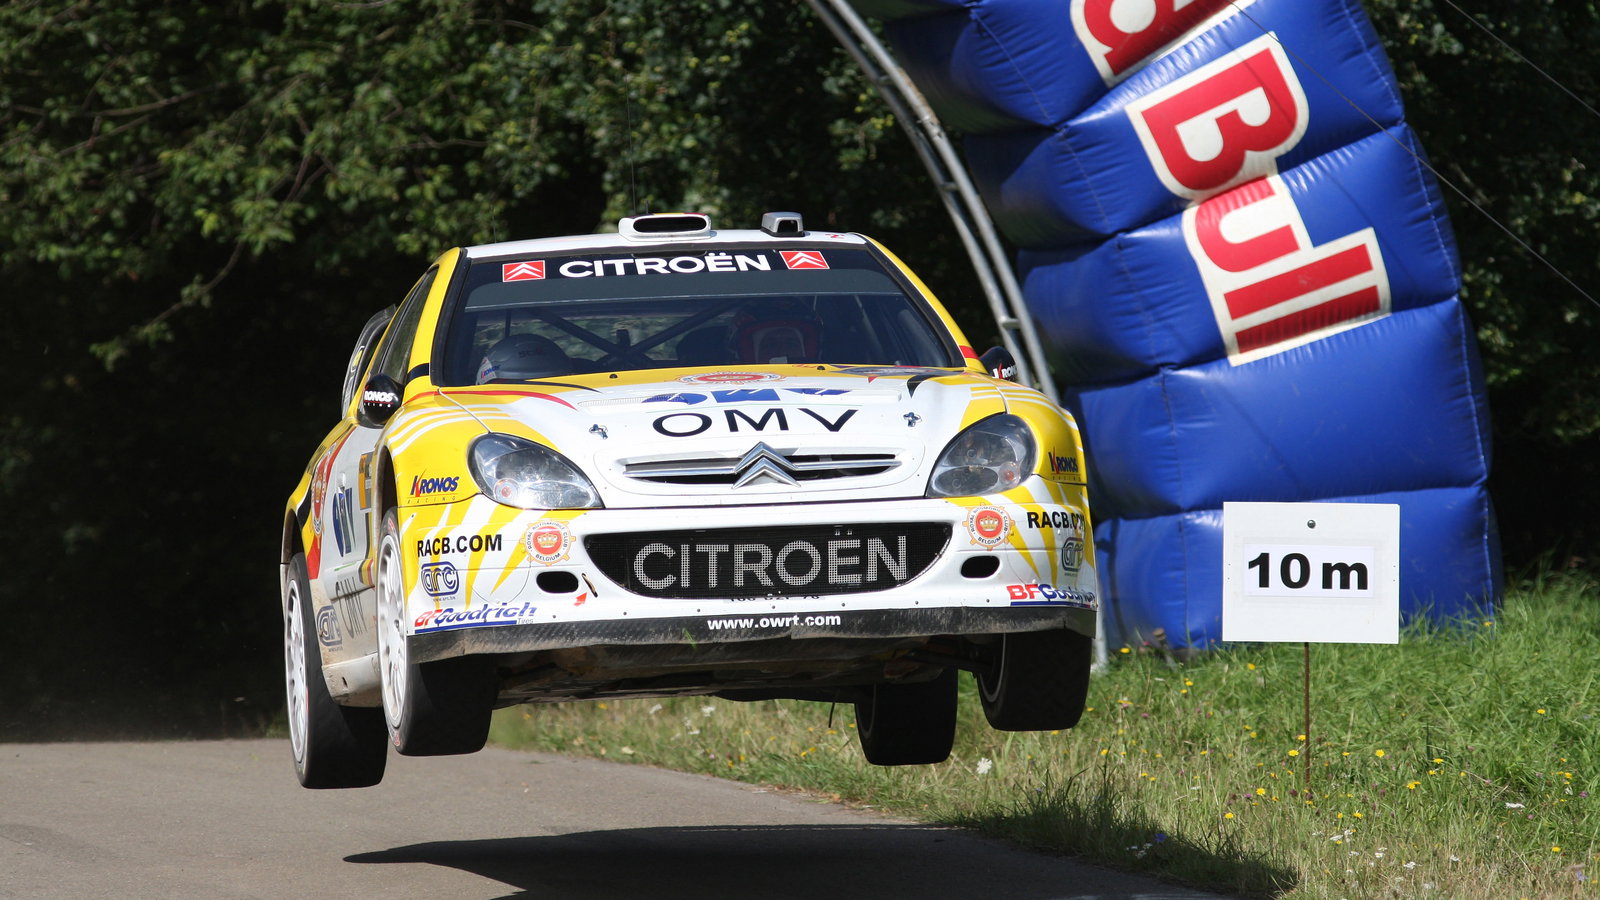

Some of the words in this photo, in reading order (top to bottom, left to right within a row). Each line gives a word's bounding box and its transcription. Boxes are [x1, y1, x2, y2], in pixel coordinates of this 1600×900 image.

[1138, 44, 1382, 356] Bull
[559, 252, 772, 278] CITROËN
[652, 408, 859, 437] OMV
[410, 472, 460, 497] KRONOS
[417, 533, 503, 558] RACB.COM
[978, 536, 1002, 545] BELGIUM
[535, 552, 561, 561] BELGIUM
[633, 529, 907, 590] CITROËN
[421, 565, 458, 593] arc
[1248, 552, 1311, 589] 10
[1322, 562, 1368, 590] m
[414, 602, 538, 627] BFGoodrich
[707, 613, 842, 630] www.owrt.com
